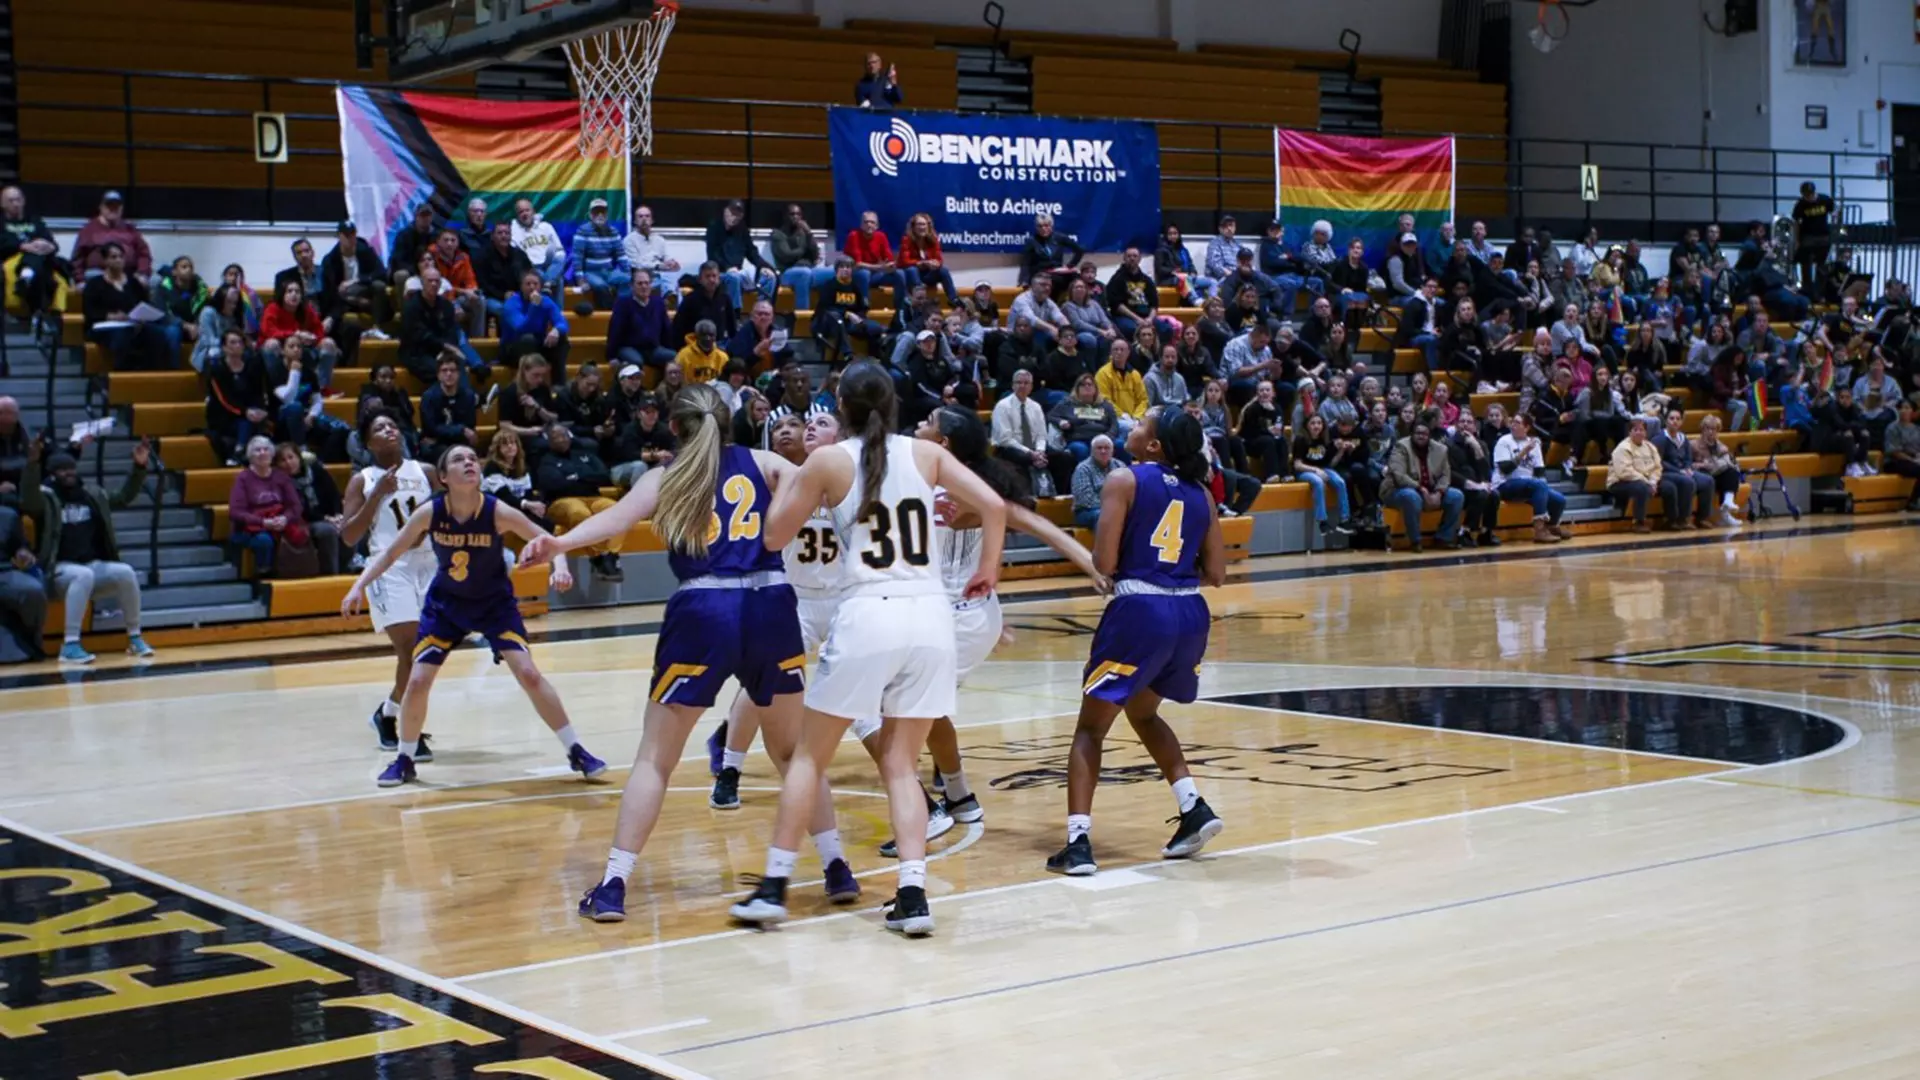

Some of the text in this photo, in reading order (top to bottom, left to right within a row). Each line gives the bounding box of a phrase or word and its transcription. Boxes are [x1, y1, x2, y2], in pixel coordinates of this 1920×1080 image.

[257, 116, 283, 159] D
[918, 133, 1115, 168] BENCHMARK
[1583, 167, 1597, 200] A
[945, 196, 1063, 215] Built to Achieve
[797, 527, 839, 565] 35
[857, 497, 930, 570] 30
[1149, 498, 1185, 564] 4
[447, 550, 470, 583] 3
